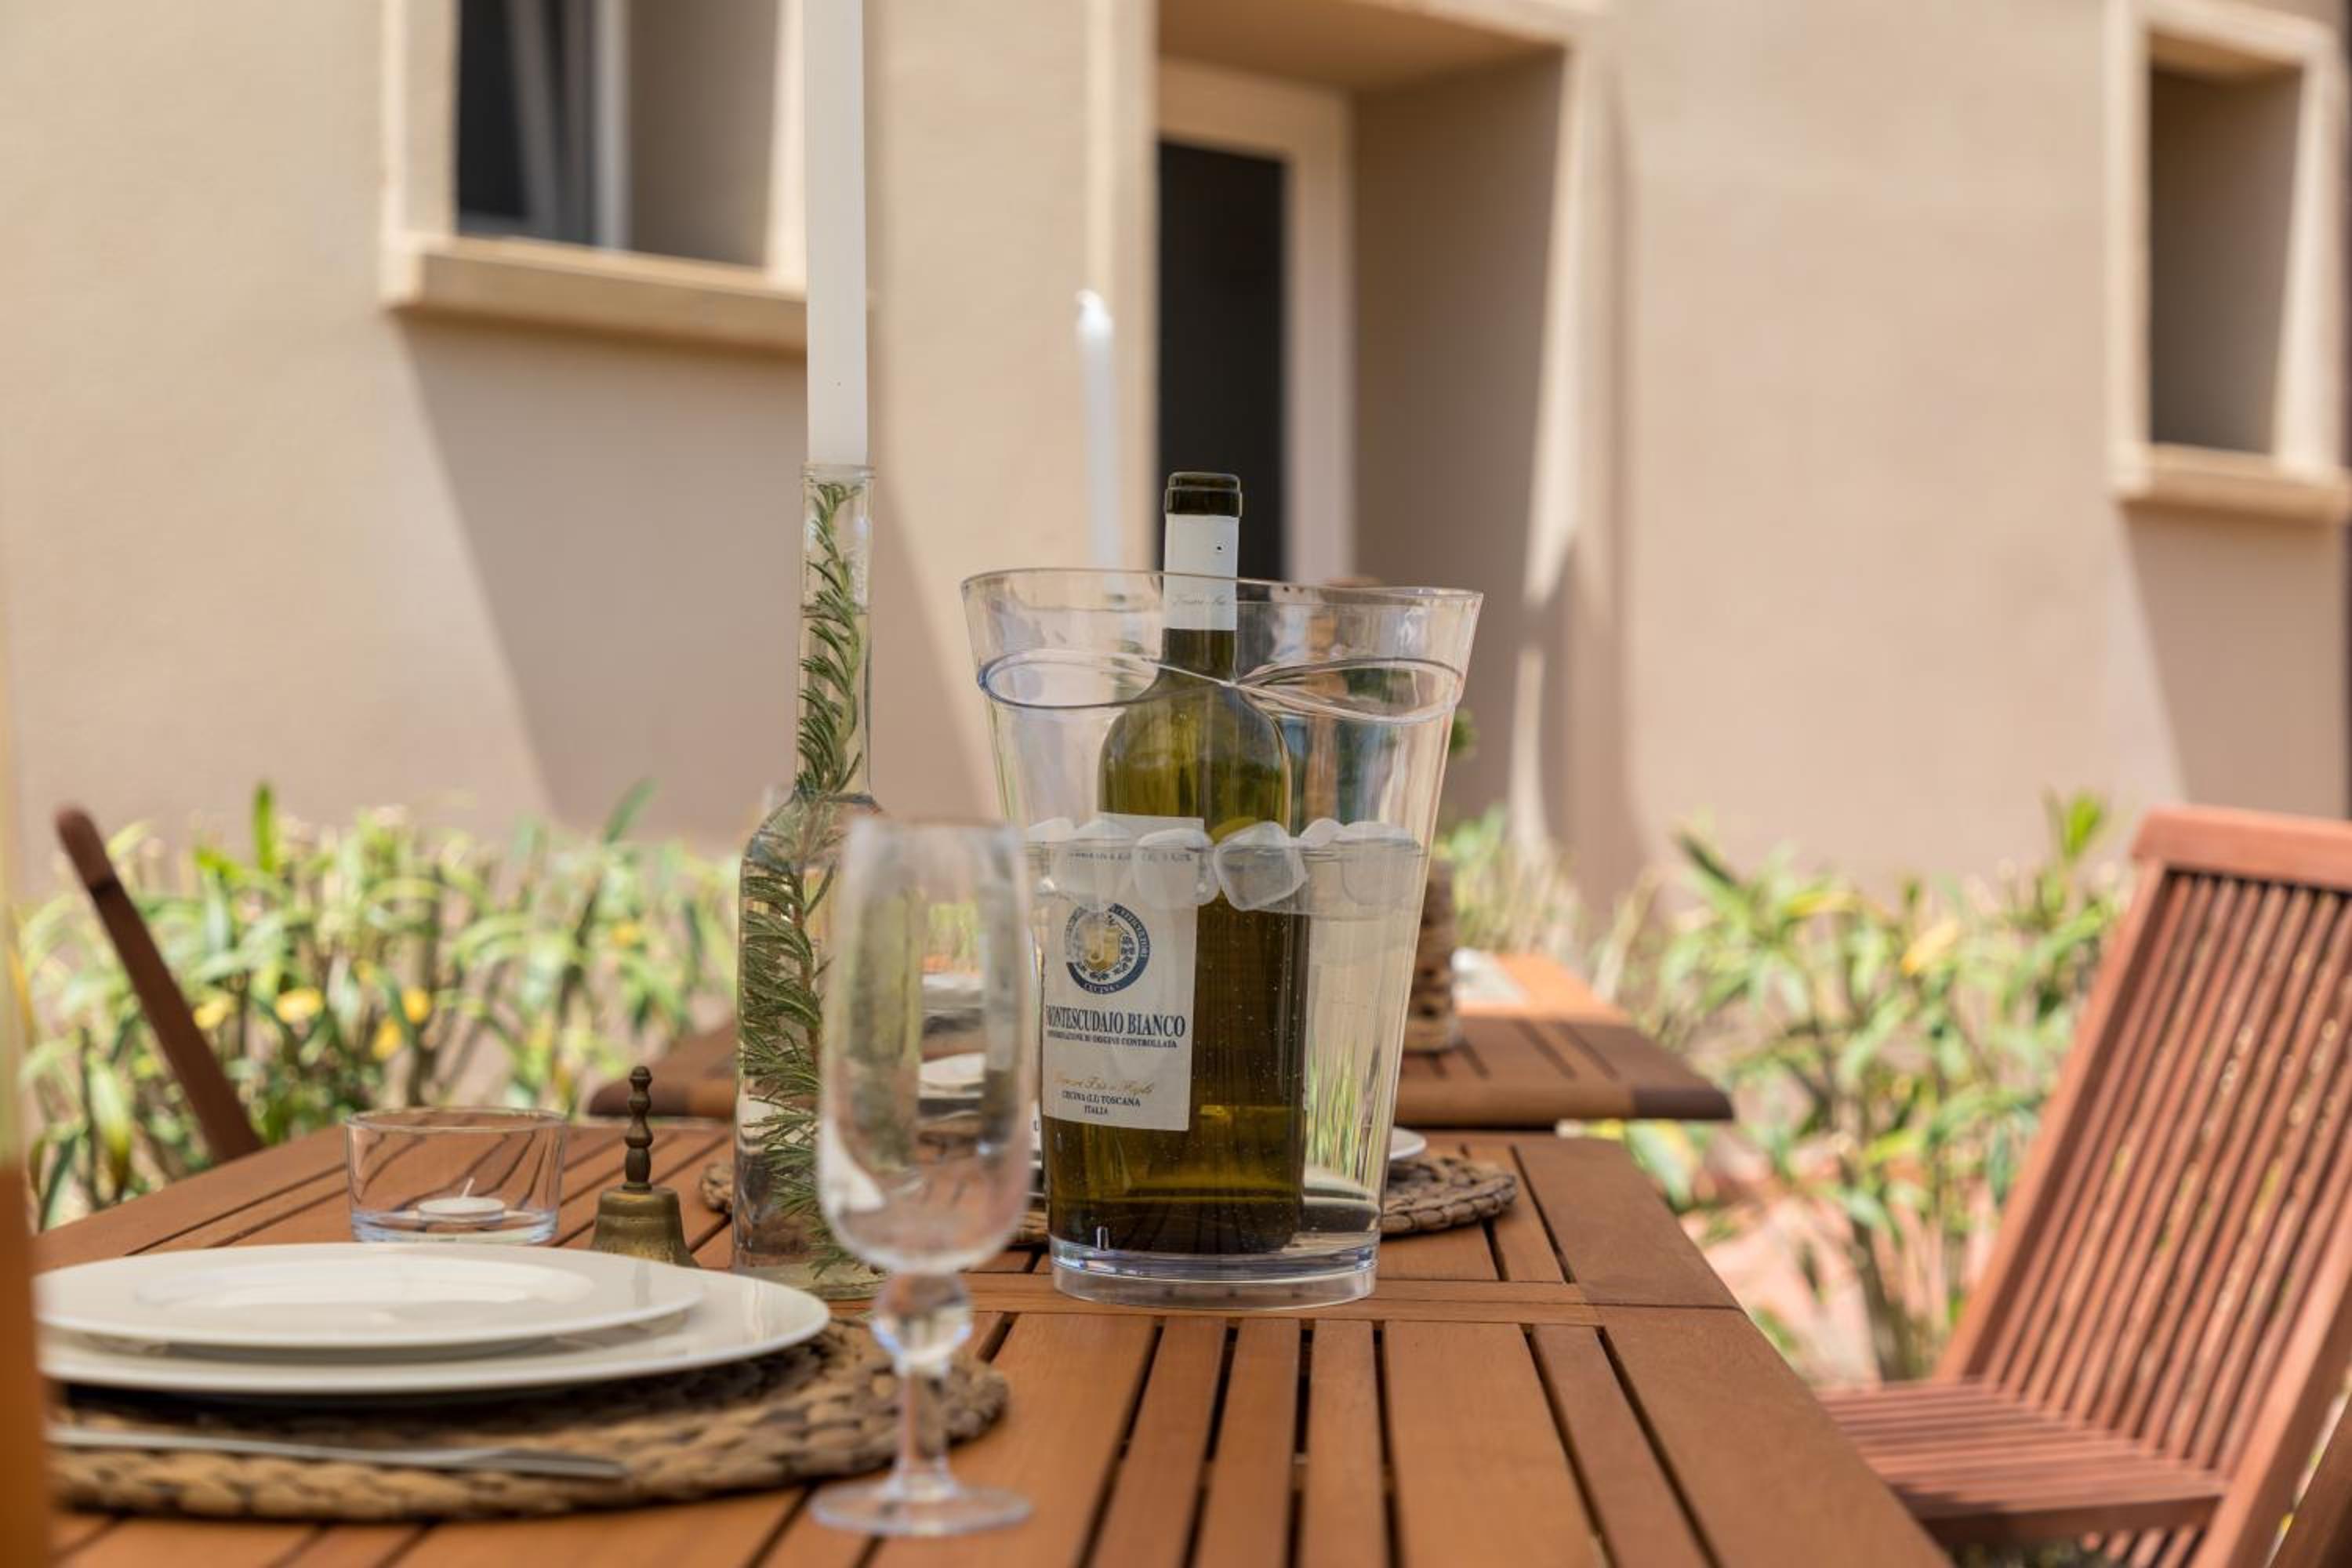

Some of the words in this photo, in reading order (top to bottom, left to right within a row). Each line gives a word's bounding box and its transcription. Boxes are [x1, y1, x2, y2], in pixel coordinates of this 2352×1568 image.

[1127, 1013, 1185, 1037] BIANCO
[1121, 1037, 1177, 1048] CONTROLLATA
[1101, 1094, 1141, 1107] TOSCANA
[1084, 1105, 1109, 1115] ITALIA
